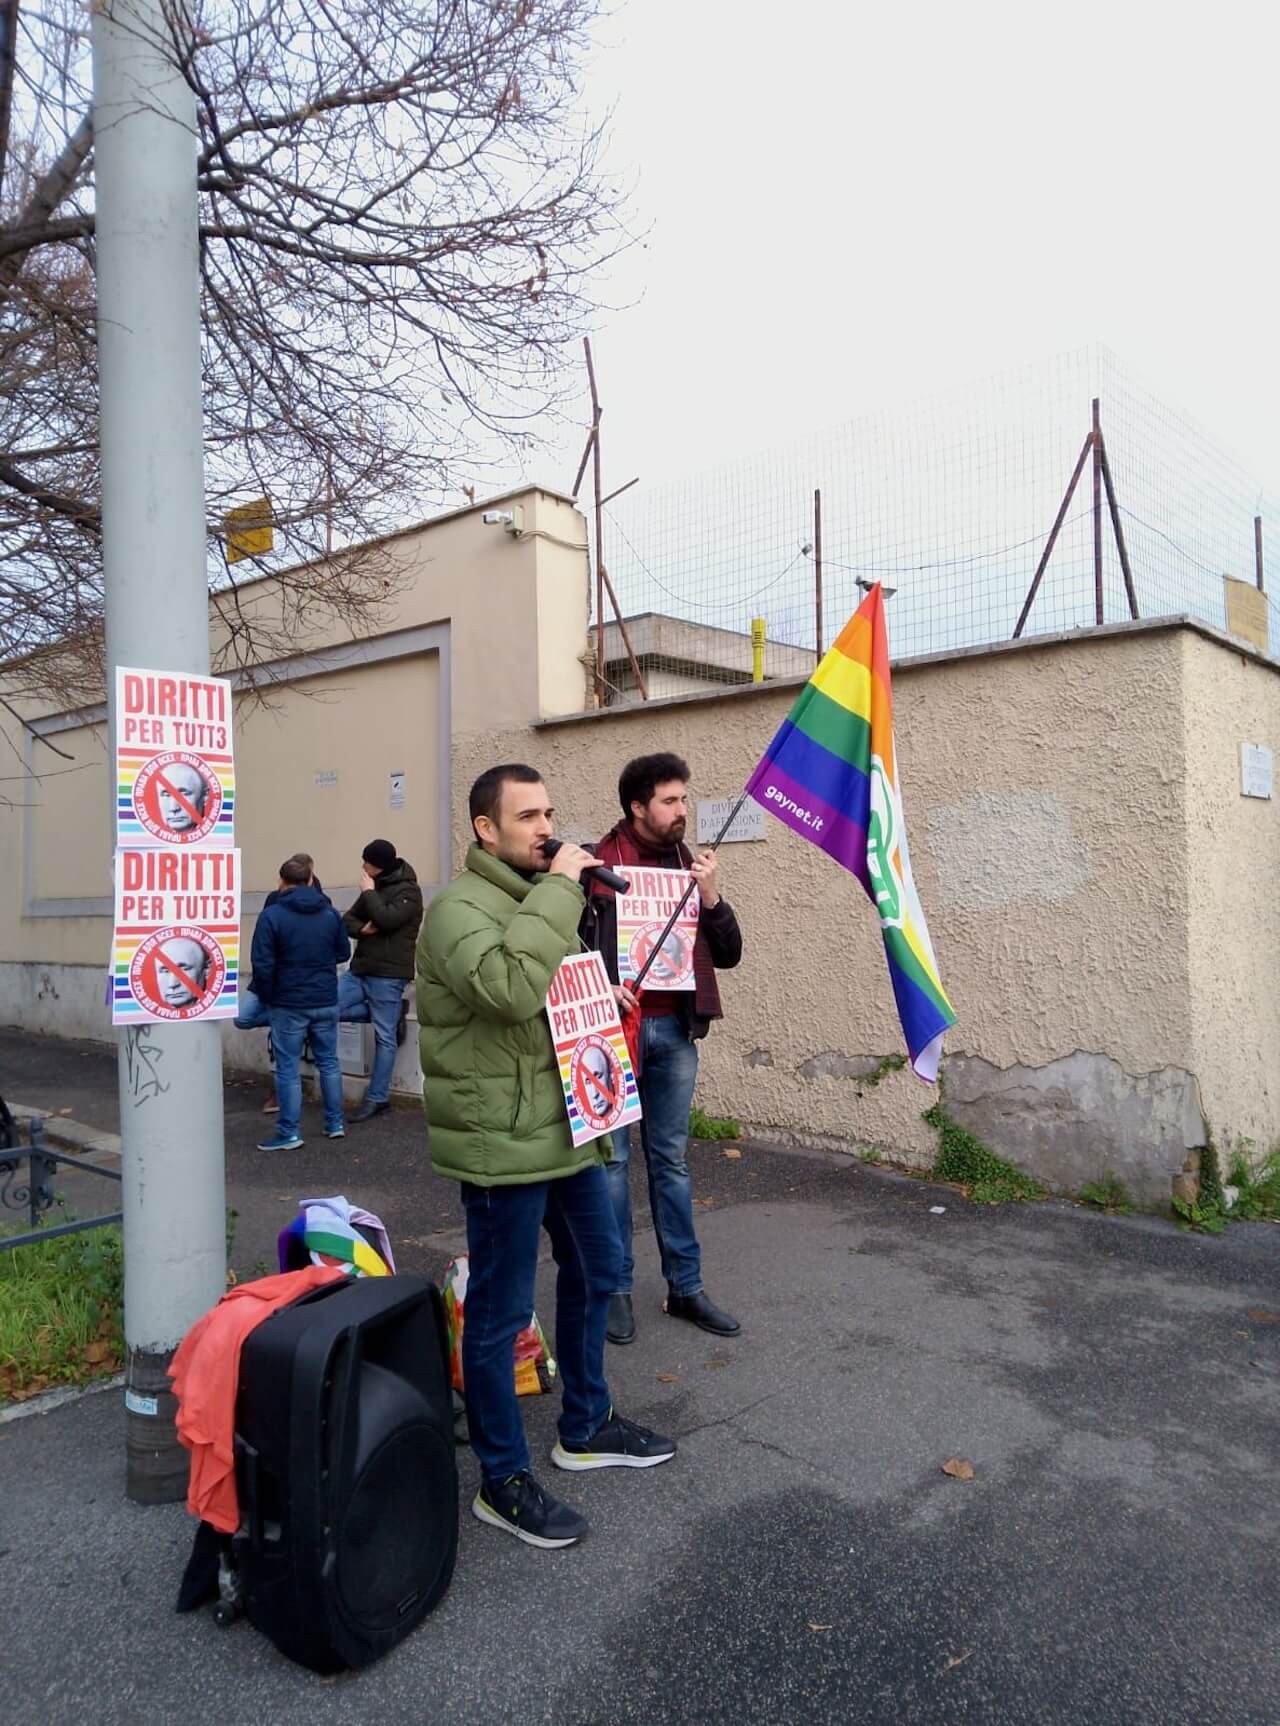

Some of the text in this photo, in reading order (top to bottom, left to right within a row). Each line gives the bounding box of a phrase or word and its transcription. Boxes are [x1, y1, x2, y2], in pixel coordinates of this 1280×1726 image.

[124, 675, 225, 721] DIRITTI
[125, 718, 226, 750] PER TUTT3
[711, 799, 749, 814] DIVIEO
[764, 785, 824, 832] gaynet.it
[123, 852, 234, 892] DIRITTI
[122, 895, 234, 921] PER TUTT3
[622, 900, 649, 916] PER
[553, 998, 615, 1037] PER TUTT3
